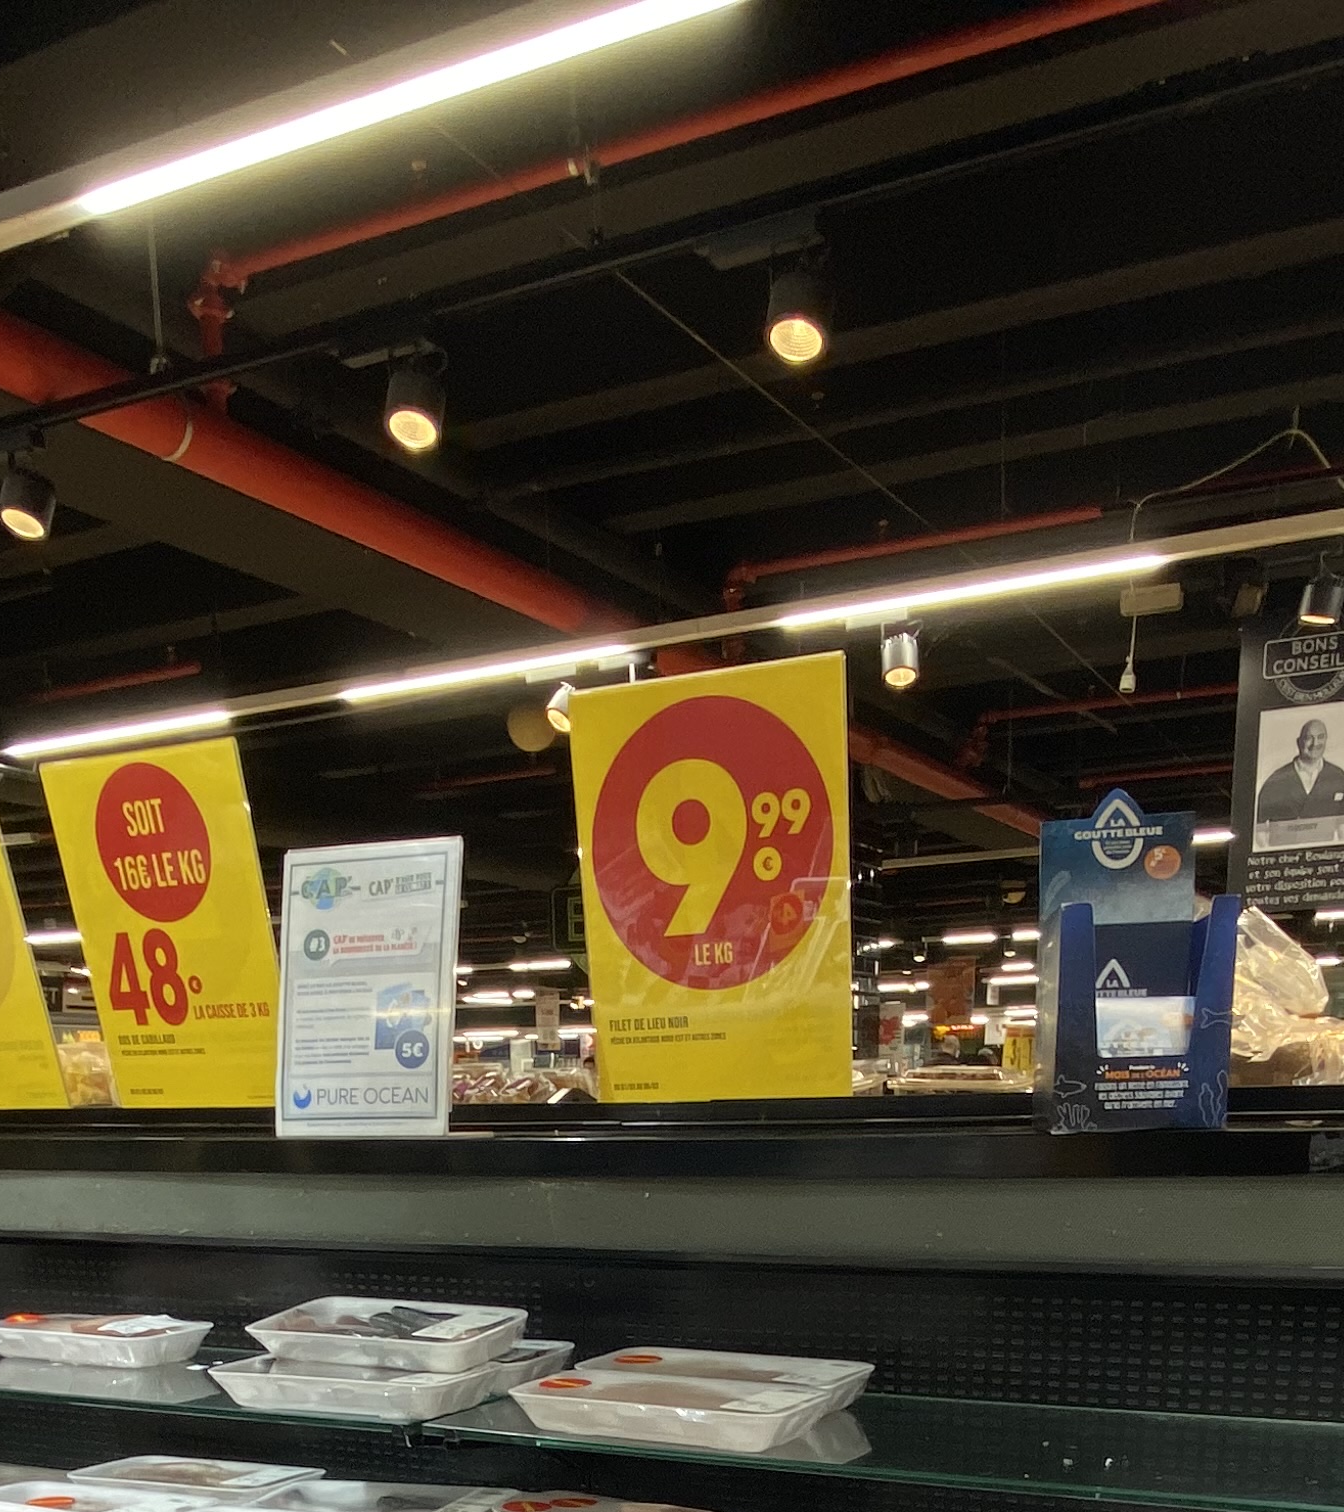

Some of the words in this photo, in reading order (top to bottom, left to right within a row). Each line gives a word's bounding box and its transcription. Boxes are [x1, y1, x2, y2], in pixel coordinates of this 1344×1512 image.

[1292, 636, 1338, 655] BONS
[122, 798, 164, 837] SOIT
[1110, 819, 1126, 827] LA
[1074, 829, 1124, 841] GOUTTE
[1125, 826, 1164, 836] BLEUE
[636, 758, 748, 937] 9
[752, 788, 810, 838] 99
[114, 855, 152, 891] 16€
[152, 852, 178, 888] LE
[177, 849, 206, 884] KG
[694, 944, 710, 966] LE
[714, 942, 733, 964] KG
[110, 928, 189, 1026] 48
[193, 1005, 206, 1020] LA
[238, 1004, 250, 1018] DE
[258, 1002, 270, 1017] KG
[610, 1019, 632, 1032] FILET
[634, 1018, 646, 1031] DE
[648, 1018, 666, 1030] LIEU
[668, 1016, 688, 1029] NOIR
[402, 1042, 424, 1058] 5€
[317, 1088, 359, 1106] PURE
[364, 1087, 428, 1105] OCEAN
